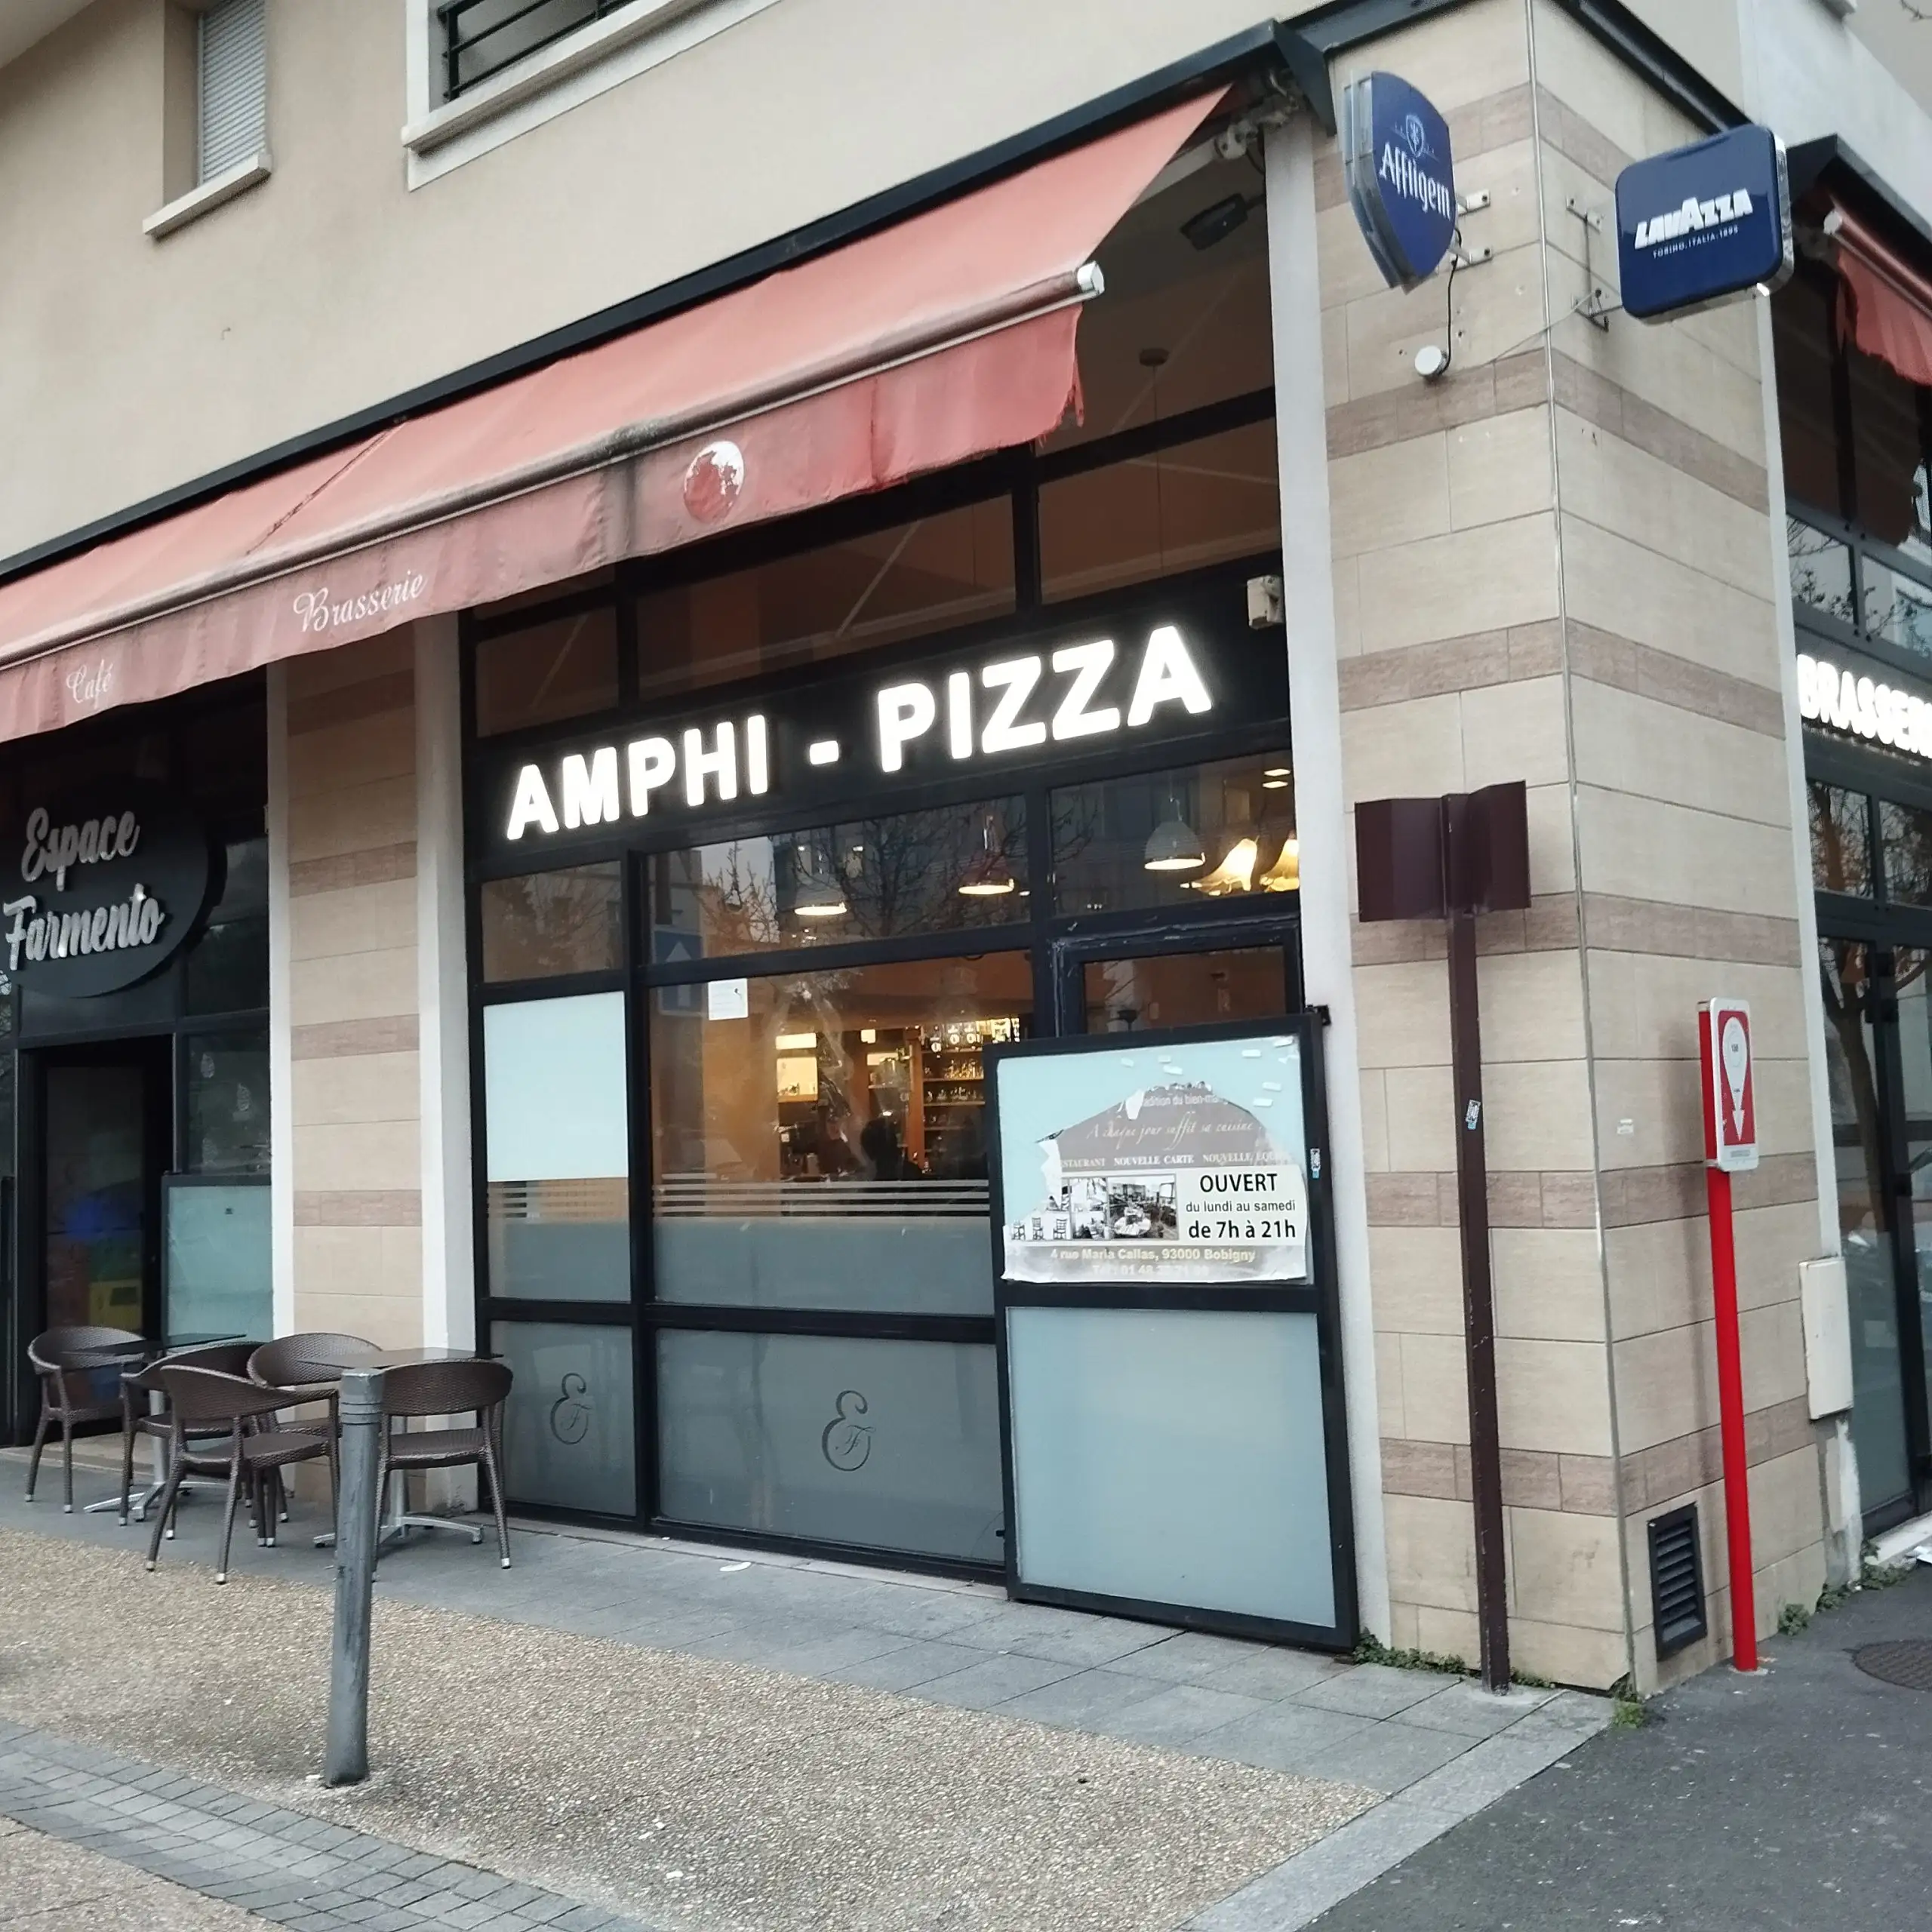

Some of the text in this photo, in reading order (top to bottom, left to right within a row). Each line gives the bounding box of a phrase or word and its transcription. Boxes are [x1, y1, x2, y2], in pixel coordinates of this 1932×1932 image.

[1379, 142, 1451, 221] Affligem
[1635, 188, 1753, 250] LAVAZZA
[294, 570, 427, 632] Brasserie
[66, 659, 114, 709] Café
[506, 626, 1213, 840] AMPHI - PIZZA
[21, 807, 141, 892] Espace
[1114, 1155, 1161, 1167] NOUVELLE
[1164, 1154, 1195, 1164] CARTE
[1199, 1174, 1278, 1193] OUVERT
[1186, 1200, 1296, 1212] du lundi au samedi
[1189, 1219, 1296, 1238] de 7h à 21h
[1060, 1250, 1079, 1260] rue
[1081, 1248, 1115, 1260] Maria
[1118, 1248, 1159, 1262] Callas,
[1162, 1248, 1201, 1260] 93000
[1204, 1248, 1256, 1263] Bobigny
